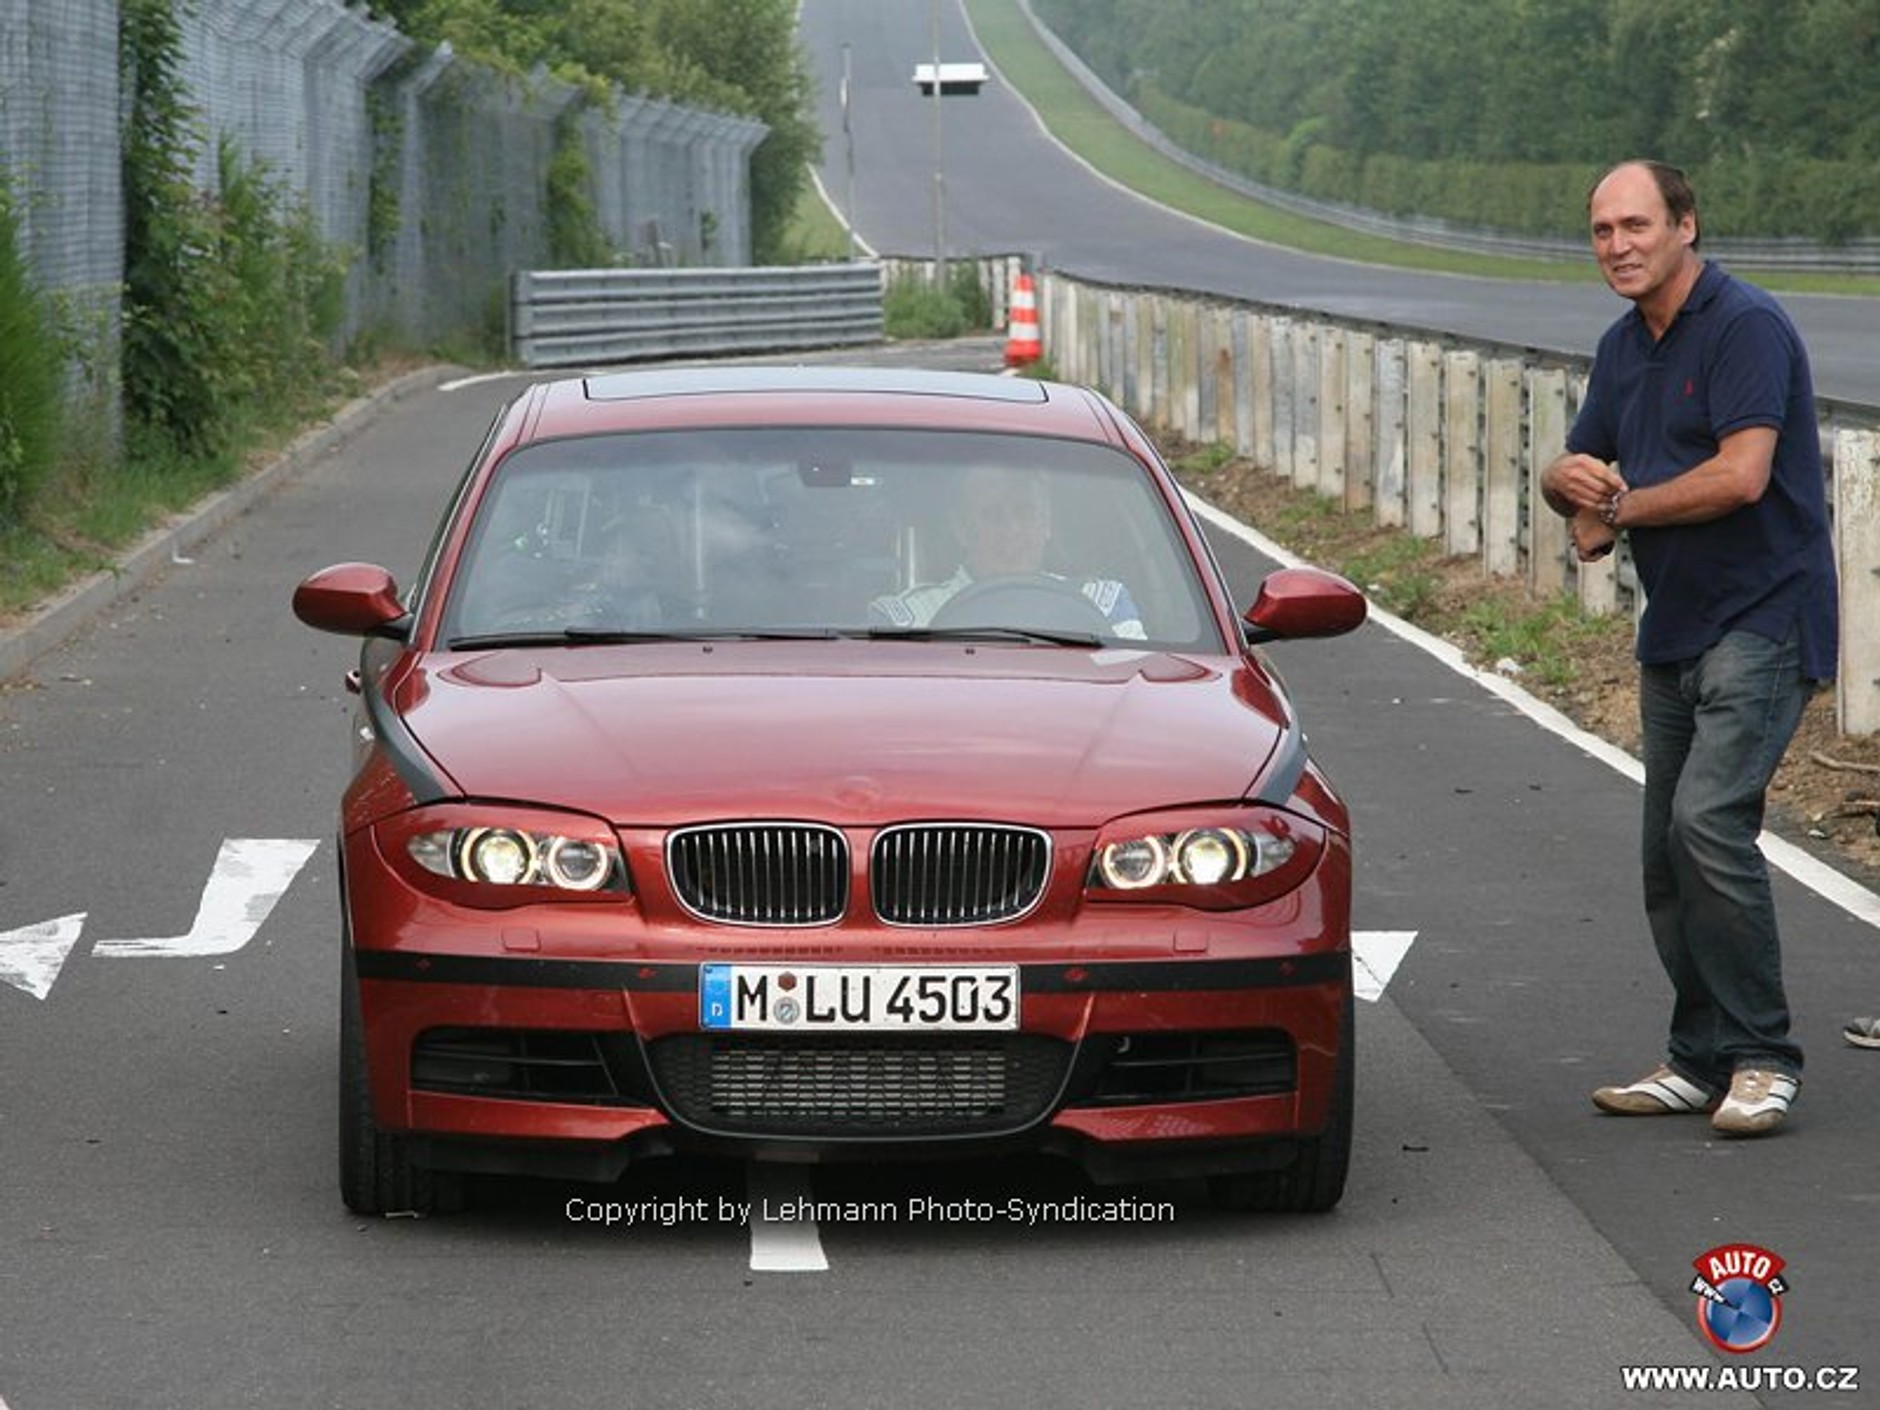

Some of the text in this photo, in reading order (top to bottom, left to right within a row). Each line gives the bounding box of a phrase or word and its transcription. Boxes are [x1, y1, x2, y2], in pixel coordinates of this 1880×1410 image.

[737, 974, 1012, 1024] M LU 4503
